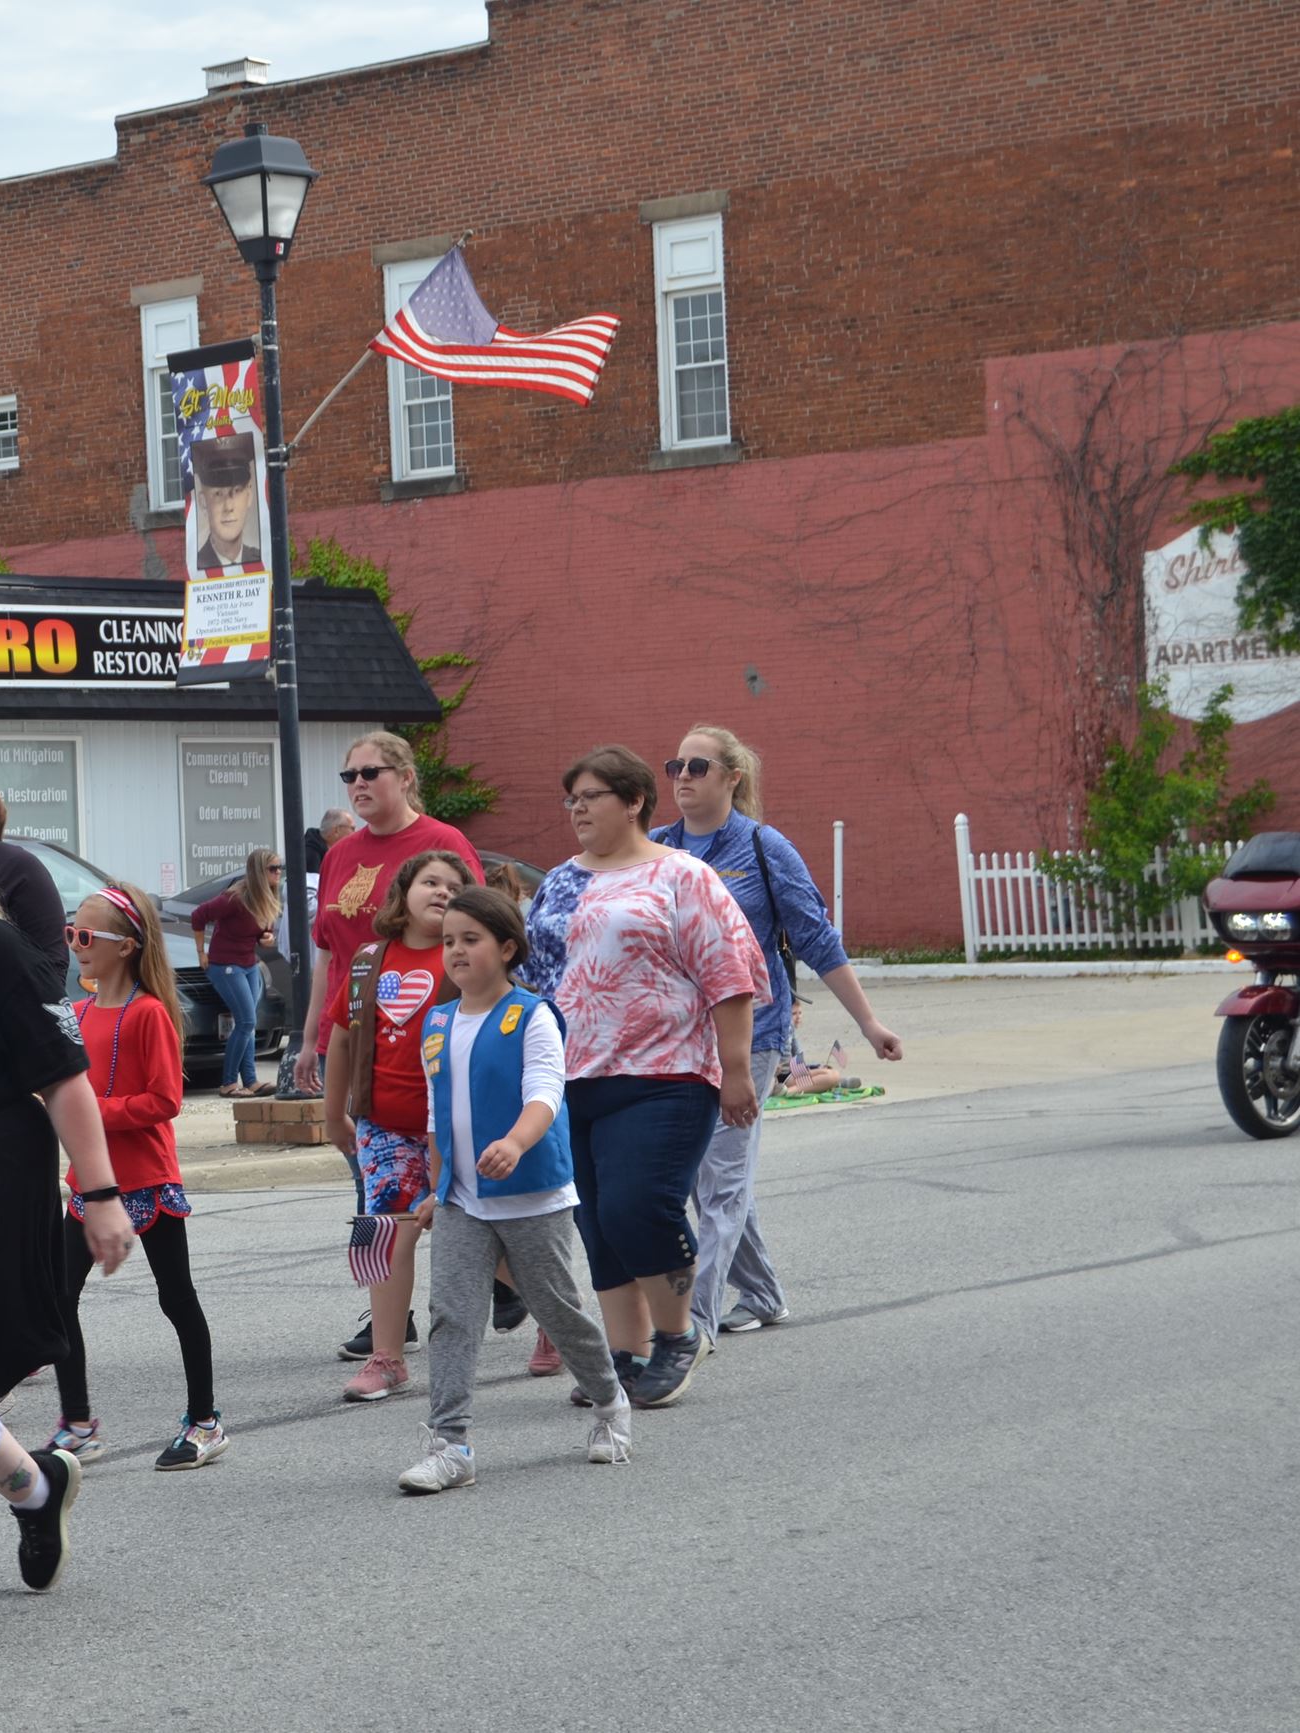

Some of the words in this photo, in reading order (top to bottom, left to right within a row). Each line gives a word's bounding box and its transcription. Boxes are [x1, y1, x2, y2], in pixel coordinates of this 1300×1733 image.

[180, 388, 206, 418] St.
[196, 590, 235, 604] KENNETH
[236, 590, 244, 600] R.
[245, 587, 261, 598] DAY
[13, 748, 64, 766] Mitigation
[186, 752, 240, 766] Commercial
[243, 752, 270, 768] Office
[209, 771, 248, 785] Cleaning
[8, 788, 67, 802] Restoration
[199, 806, 220, 820] Odor
[223, 805, 261, 820] Removal
[24, 825, 68, 842] Cleaning
[192, 843, 245, 858] Commercial
[199, 862, 222, 876] Floor
